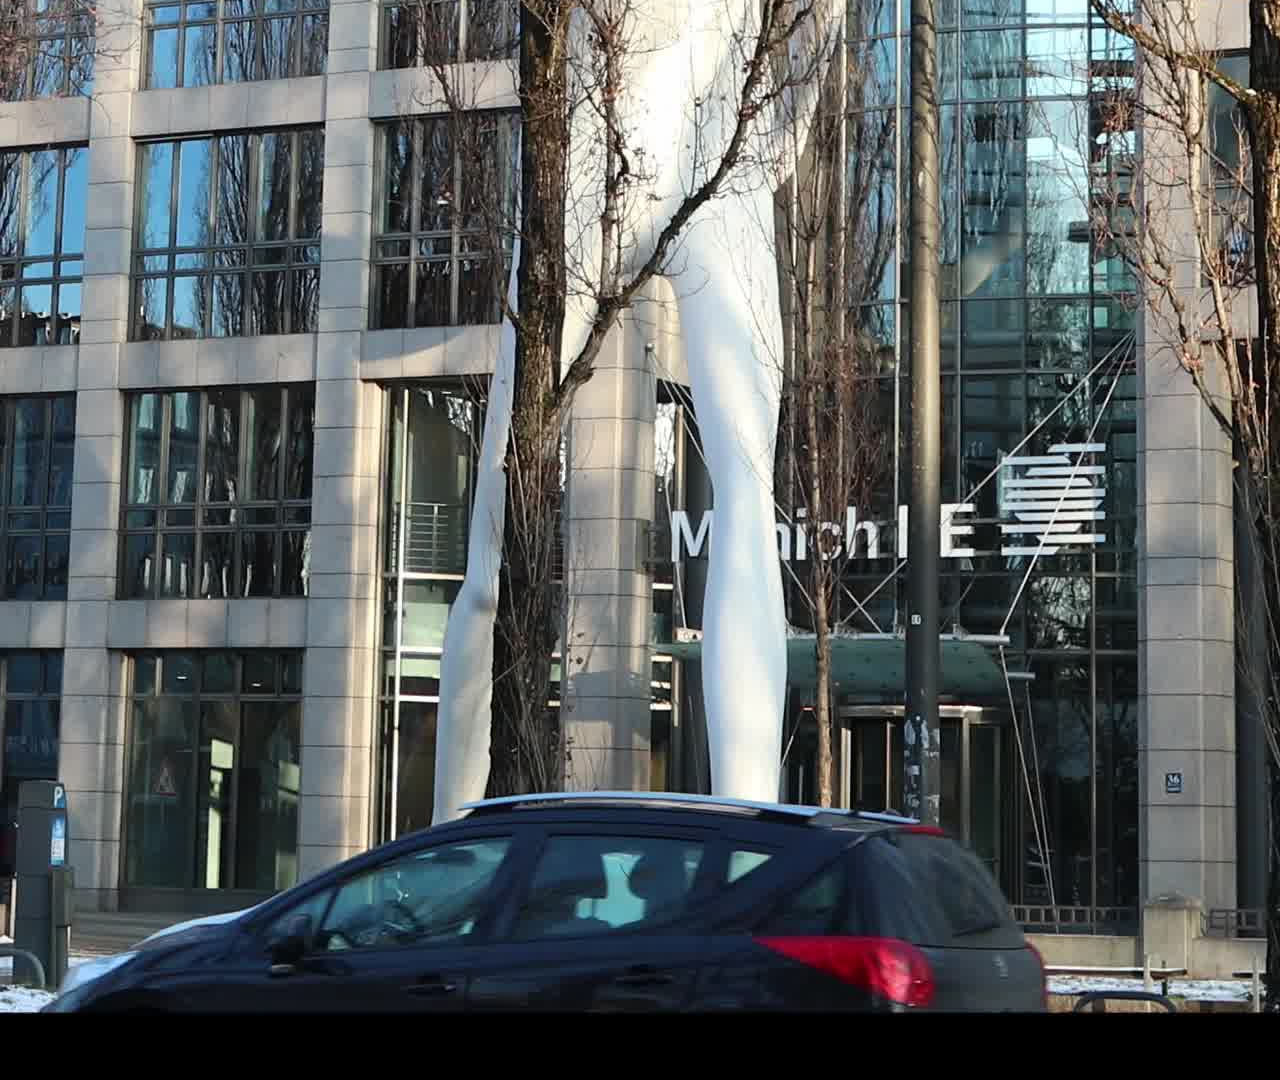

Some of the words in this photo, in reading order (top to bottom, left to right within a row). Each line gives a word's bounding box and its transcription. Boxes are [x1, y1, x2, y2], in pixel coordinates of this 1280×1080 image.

[671, 506, 879, 562] Mnich
[898, 503, 976, 559] E
[53, 786, 63, 809] P
